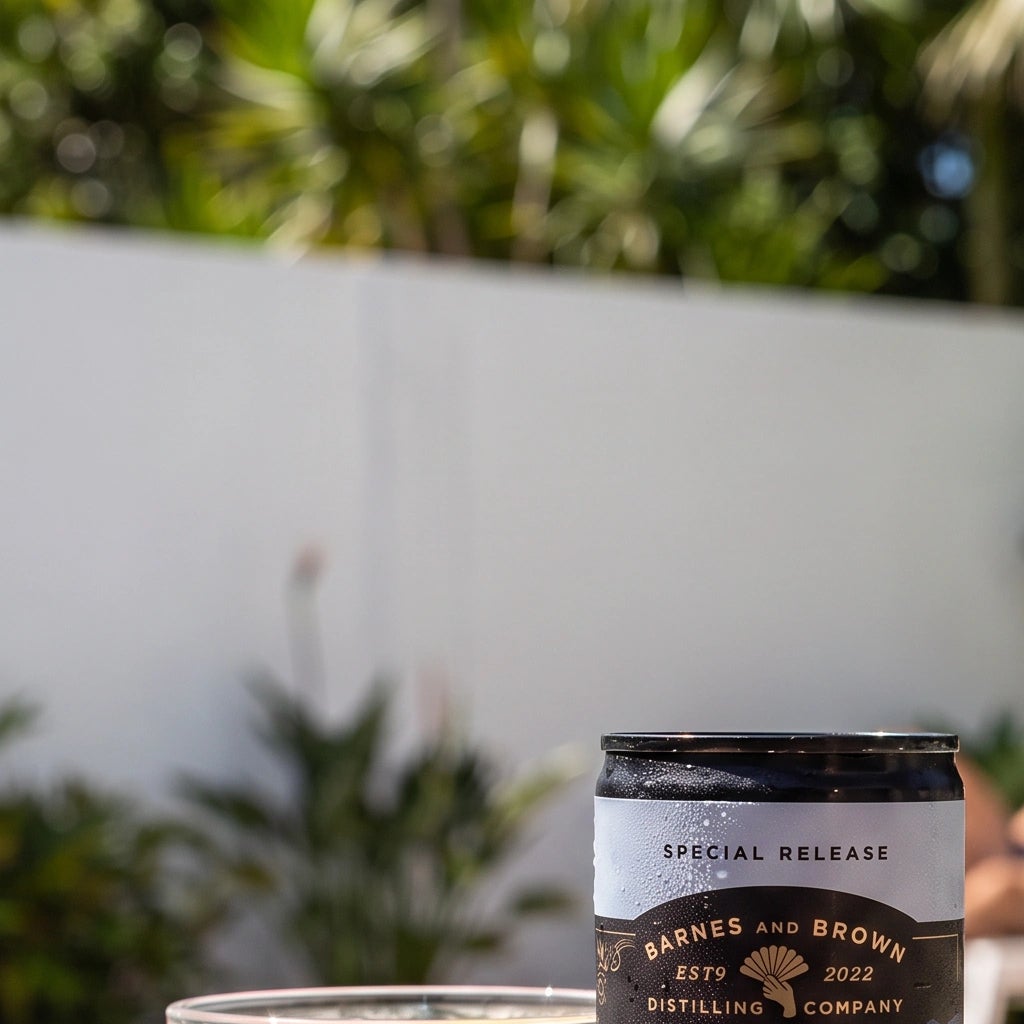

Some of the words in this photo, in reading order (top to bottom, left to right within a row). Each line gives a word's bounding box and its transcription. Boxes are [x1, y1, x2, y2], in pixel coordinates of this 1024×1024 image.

[664, 844, 764, 861] SPECIAL
[779, 845, 889, 861] RELEASE
[644, 917, 742, 961] BARNES
[755, 921, 799, 934] AND
[813, 919, 906, 963] BROWN
[823, 966, 874, 981] 2022
[648, 997, 763, 1015] DISTILLING
[803, 998, 903, 1015] COMPANY
